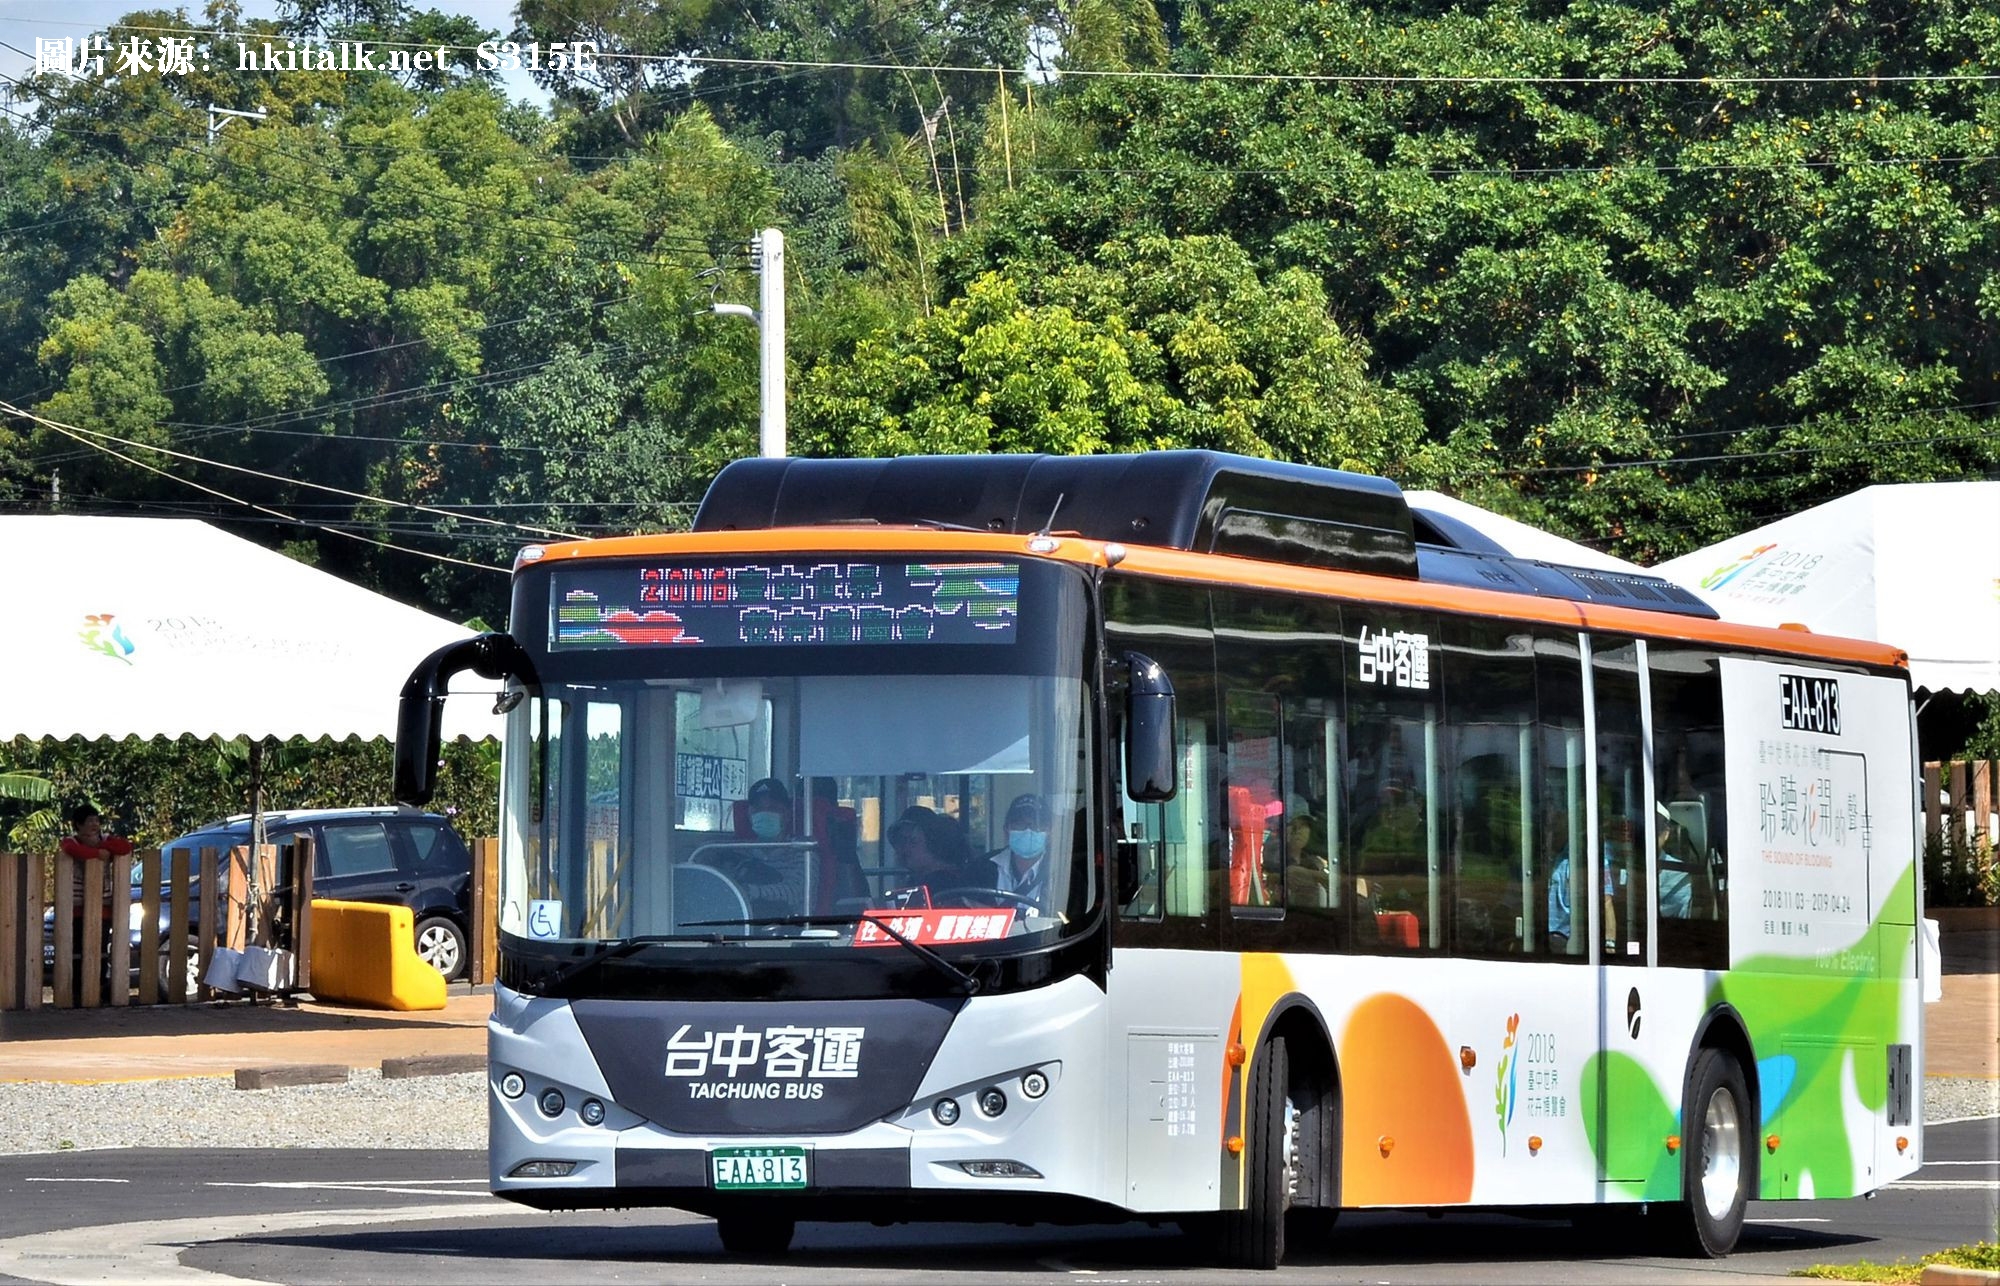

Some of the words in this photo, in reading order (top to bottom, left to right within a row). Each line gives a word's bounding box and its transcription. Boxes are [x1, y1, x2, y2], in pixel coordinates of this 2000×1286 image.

[1767, 551, 1823, 570] 2018
[1359, 625, 1430, 690] 台中客運
[1780, 676, 1840, 734] EAA-813
[1840, 949, 1875, 973] Electric
[665, 1025, 865, 1077] 台中客運
[1528, 1033, 1555, 1064] 2018
[689, 1083, 780, 1099] TAICHUNG
[785, 1083, 824, 1099] BUS
